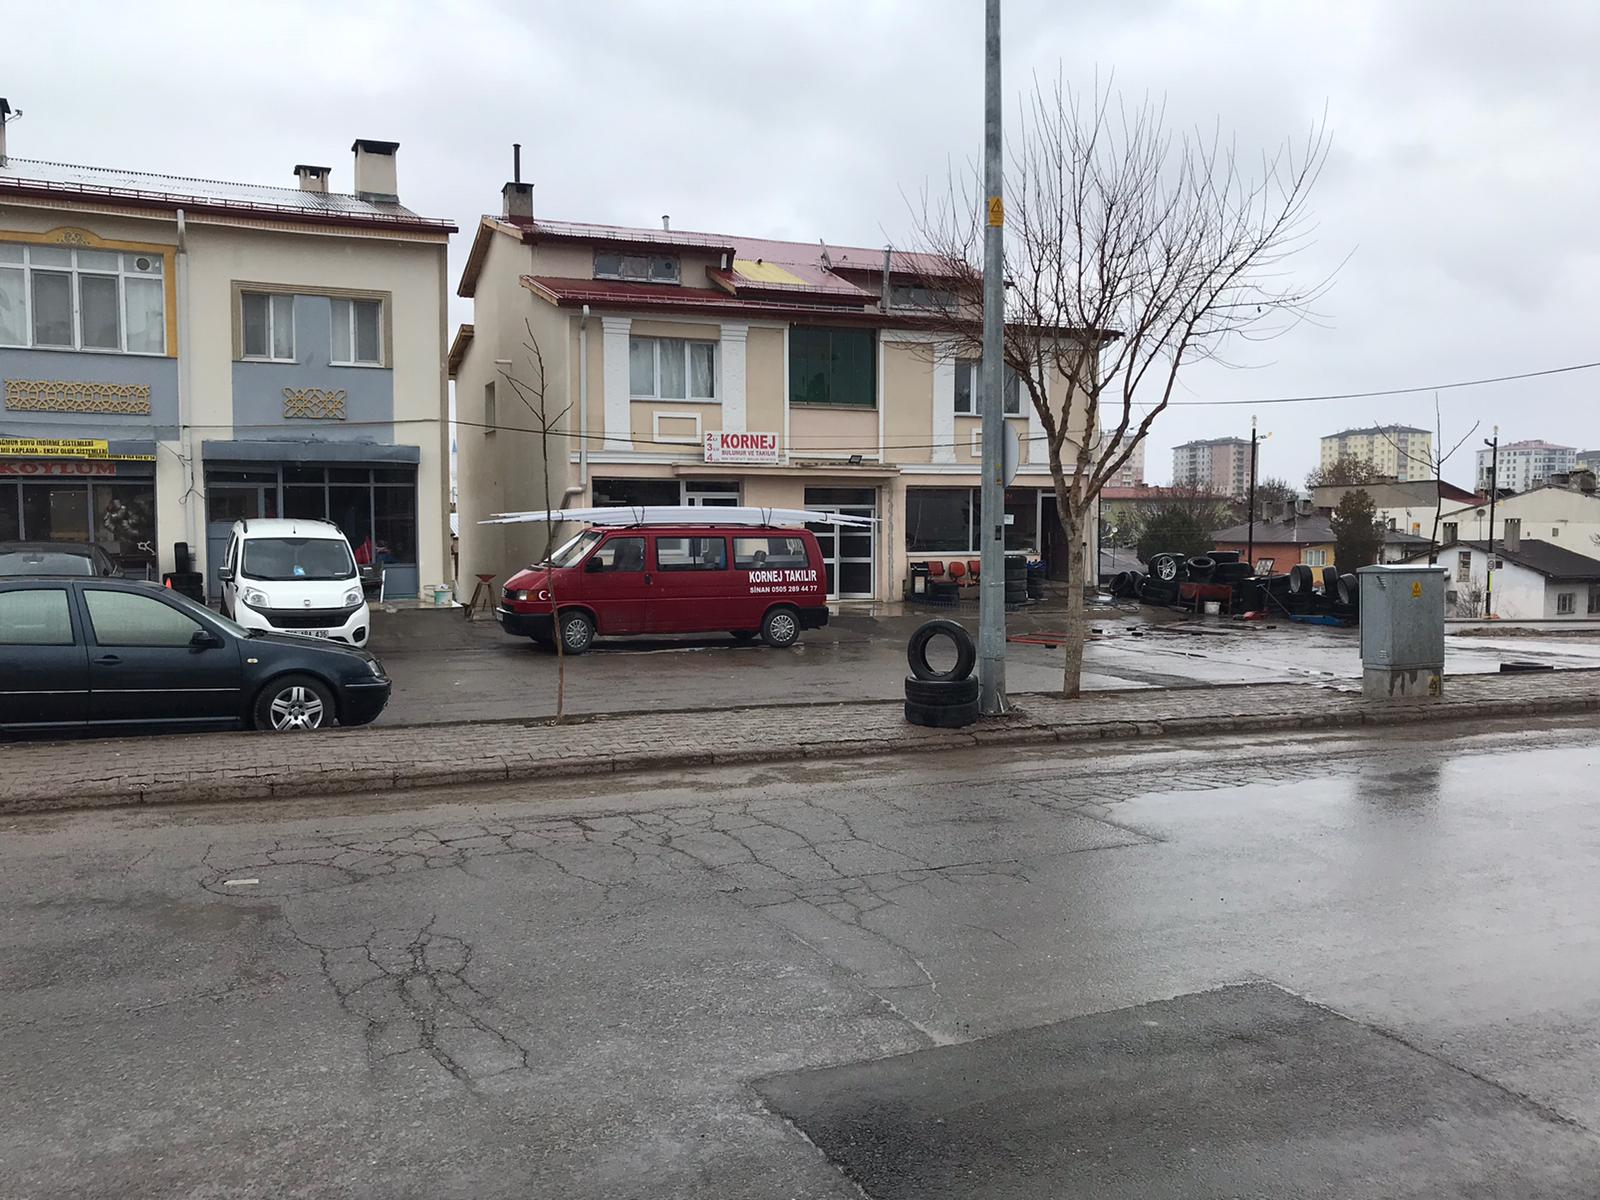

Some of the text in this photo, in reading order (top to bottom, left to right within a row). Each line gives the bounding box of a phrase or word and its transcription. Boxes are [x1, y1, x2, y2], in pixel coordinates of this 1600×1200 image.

[721, 434, 776, 449] KORNEJ
[749, 570, 817, 583] KORNEJ TAKILIR
[750, 585, 770, 593] SİNAN
